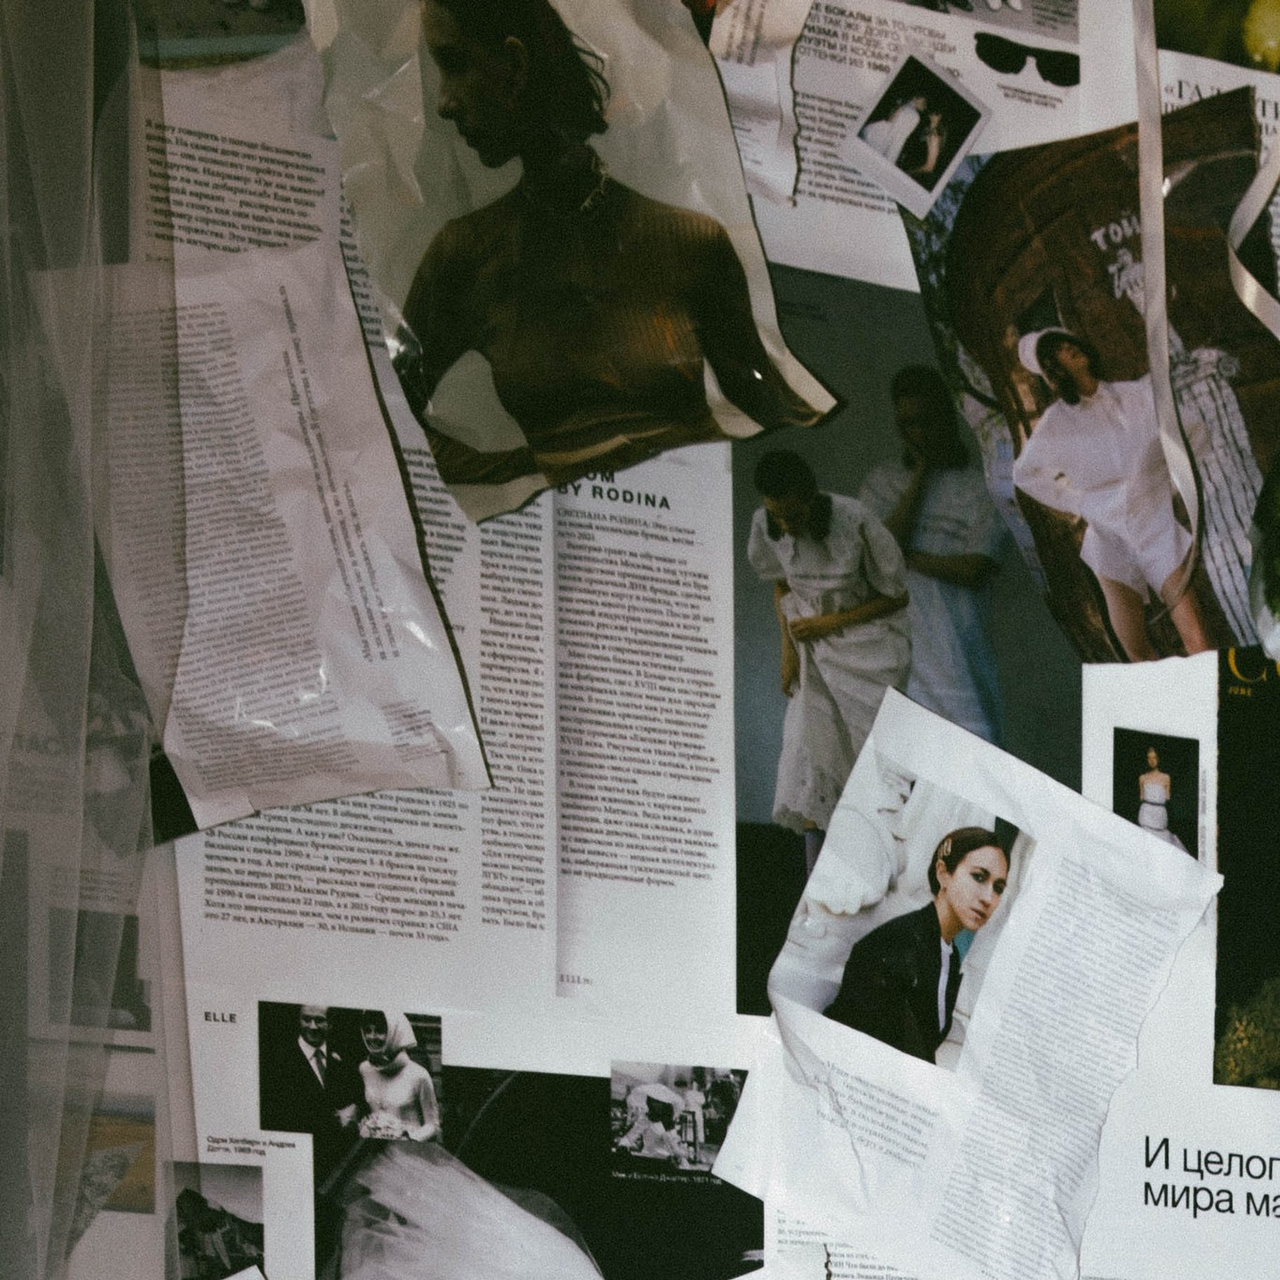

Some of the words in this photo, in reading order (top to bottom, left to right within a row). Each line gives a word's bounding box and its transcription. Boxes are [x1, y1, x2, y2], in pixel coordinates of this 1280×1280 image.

[592, 484, 671, 511] RODINA
[205, 1011, 237, 1023] ELLE
[1144, 1135, 1170, 1170] И
[1144, 1181, 1235, 1218] мира
